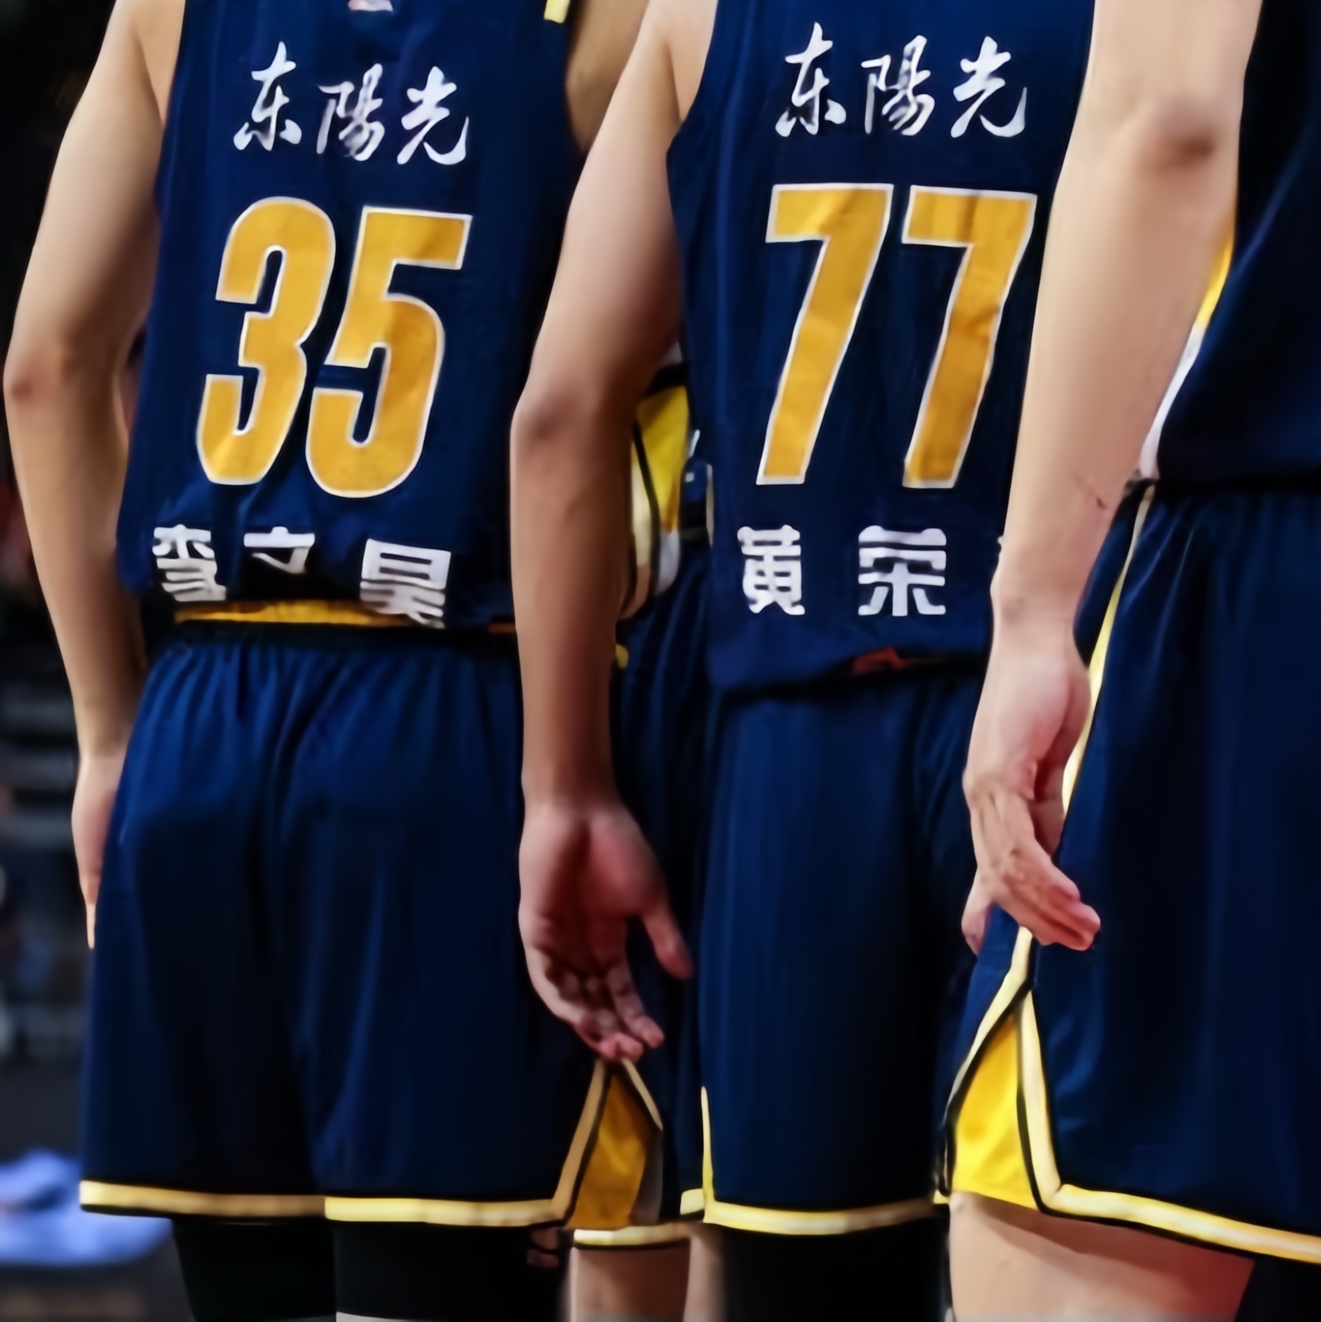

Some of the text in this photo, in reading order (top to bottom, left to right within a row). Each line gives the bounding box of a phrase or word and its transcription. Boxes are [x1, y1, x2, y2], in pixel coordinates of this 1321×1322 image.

[233, 41, 469, 166] 东陽光
[775, 21, 1028, 138] 东陽光
[196, 196, 473, 499] 35
[755, 182, 1038, 489] 77
[736, 524, 1004, 617] 黄荣
